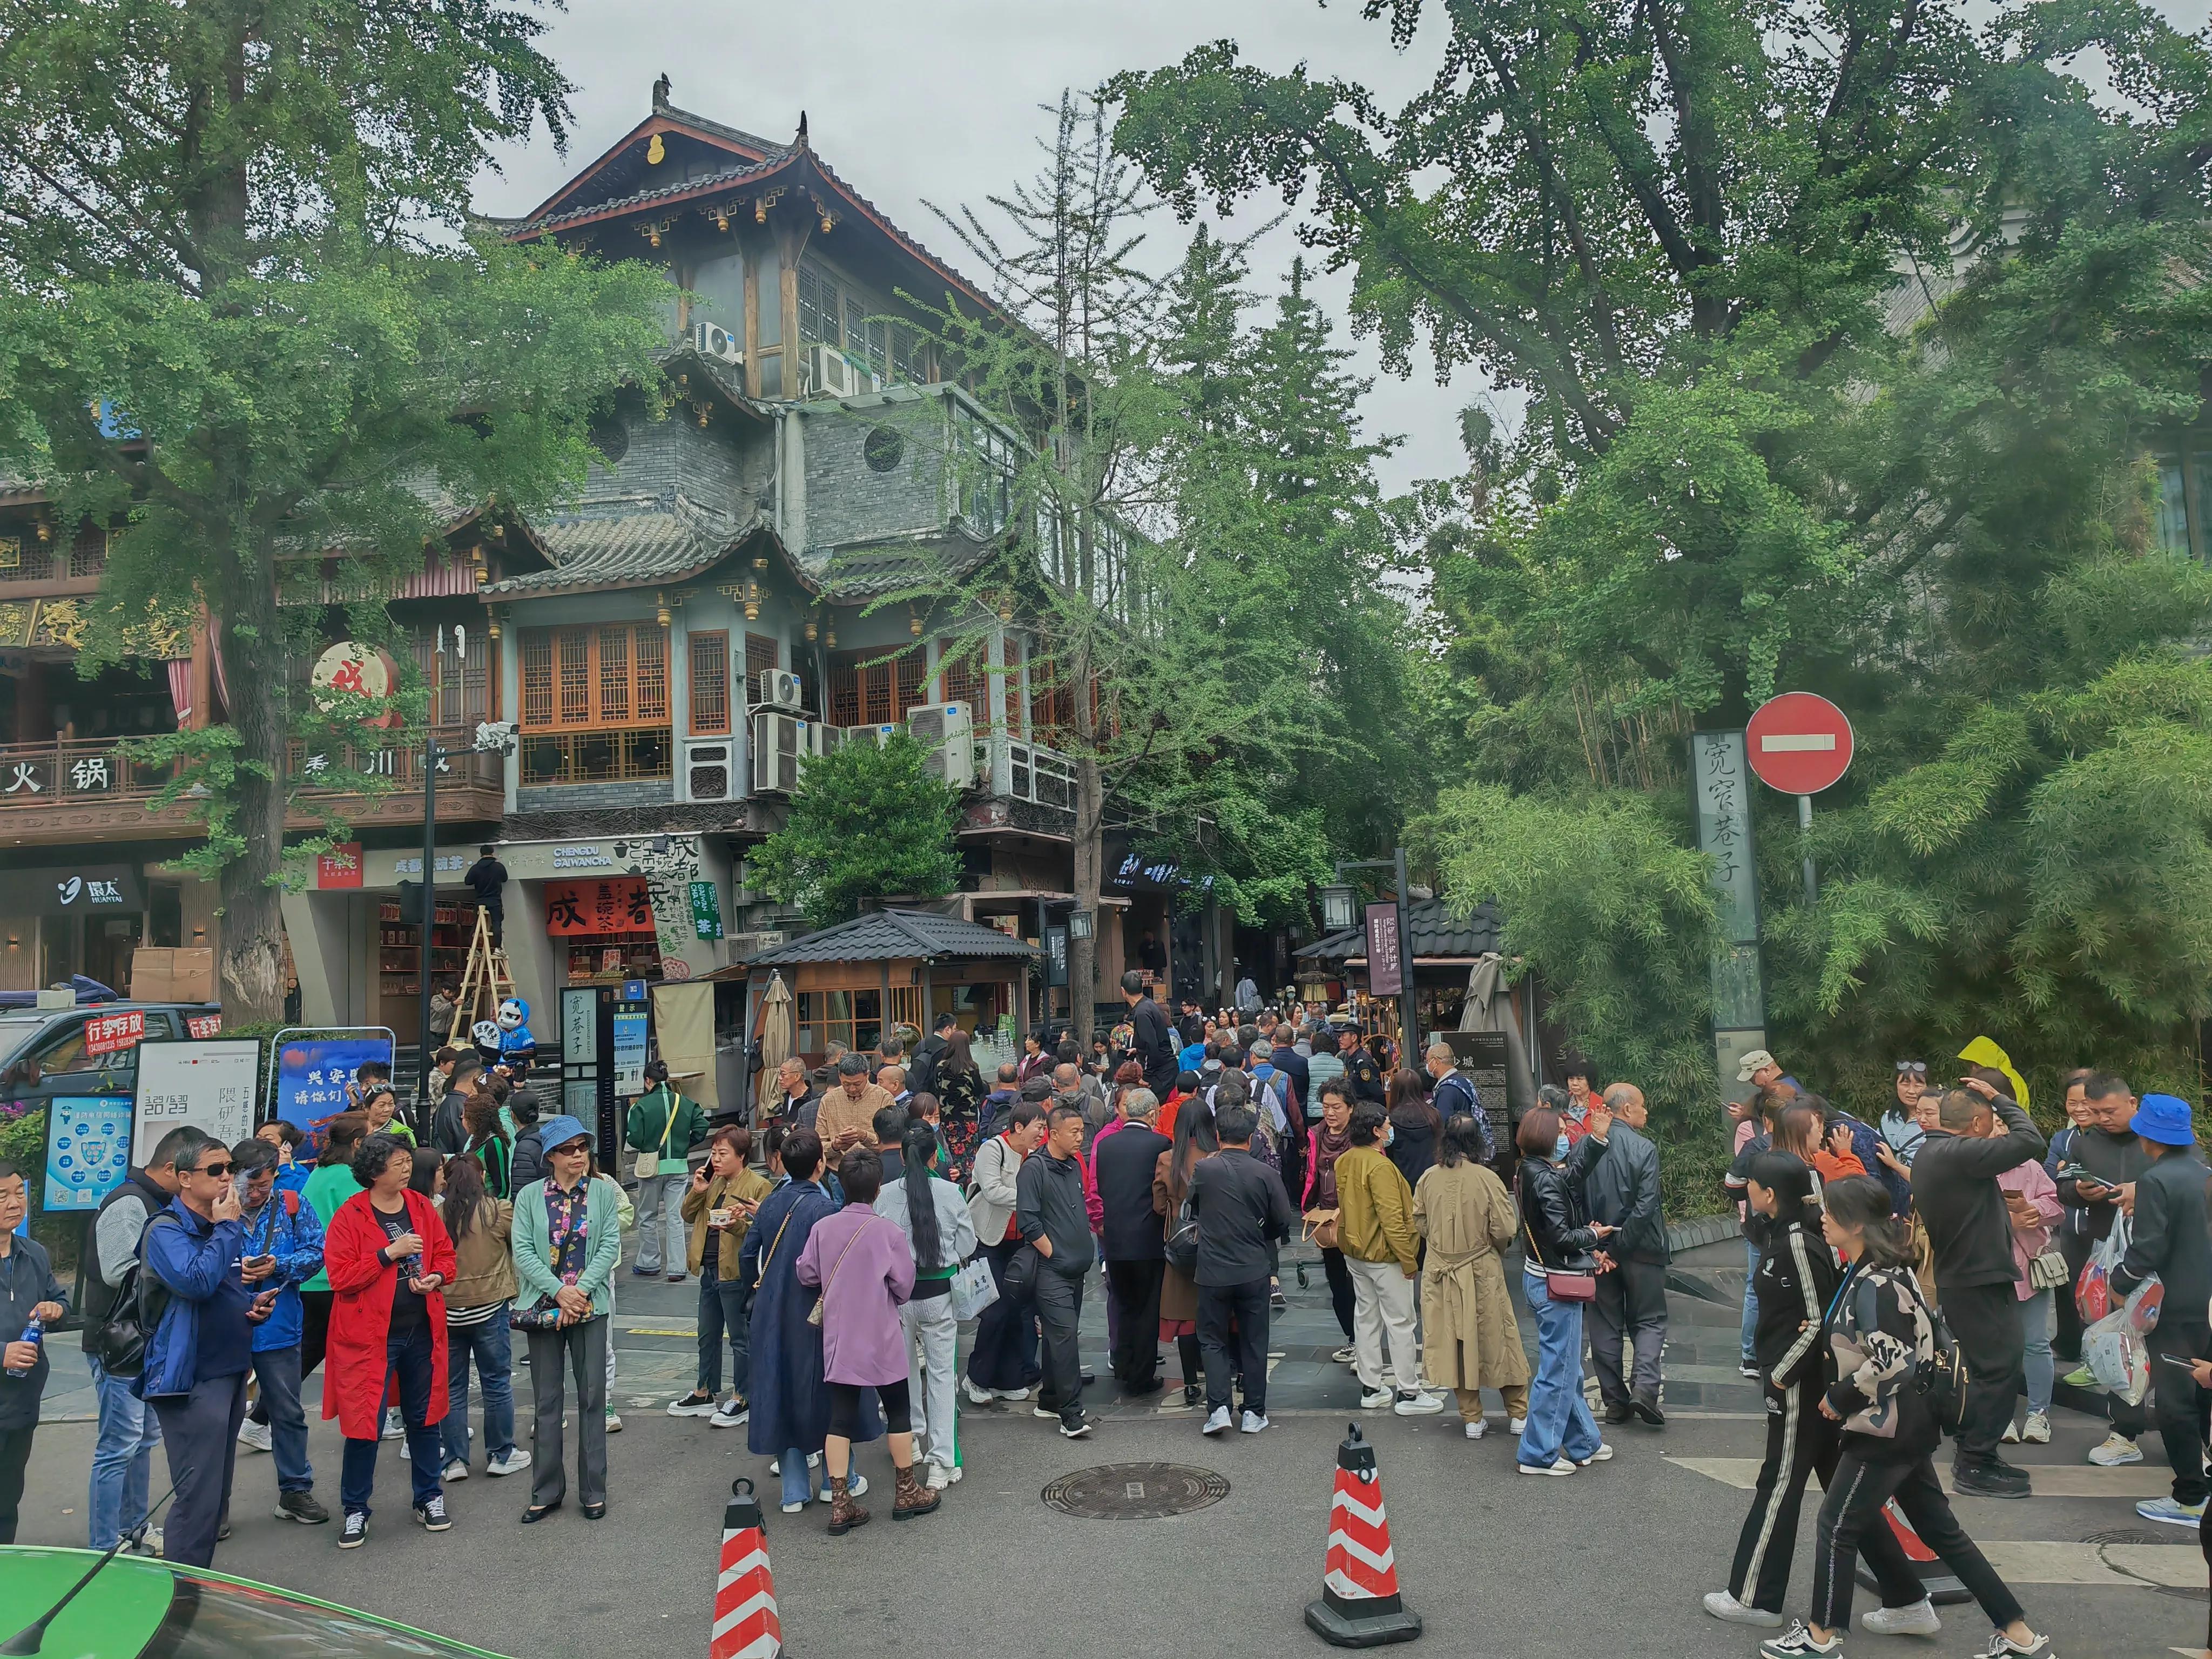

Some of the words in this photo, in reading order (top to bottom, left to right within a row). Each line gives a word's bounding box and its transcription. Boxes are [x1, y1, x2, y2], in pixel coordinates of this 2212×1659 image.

[5, 758, 108, 792] 火锅
[1704, 743, 1741, 882] 宽窄巷子
[553, 846, 599, 857] CHENGDU
[394, 855, 463, 873] 成都碗茶
[553, 856, 612, 868] GAIWANCHA
[697, 884, 708, 912] GAIWAN
[697, 919, 712, 933] 茶
[88, 1014, 142, 1042] 行李存放
[570, 995, 584, 1054] 宽巷子
[294, 1089, 350, 1105] 请你们
[145, 1104, 164, 1115] 20
[168, 1103, 187, 1115] 23
